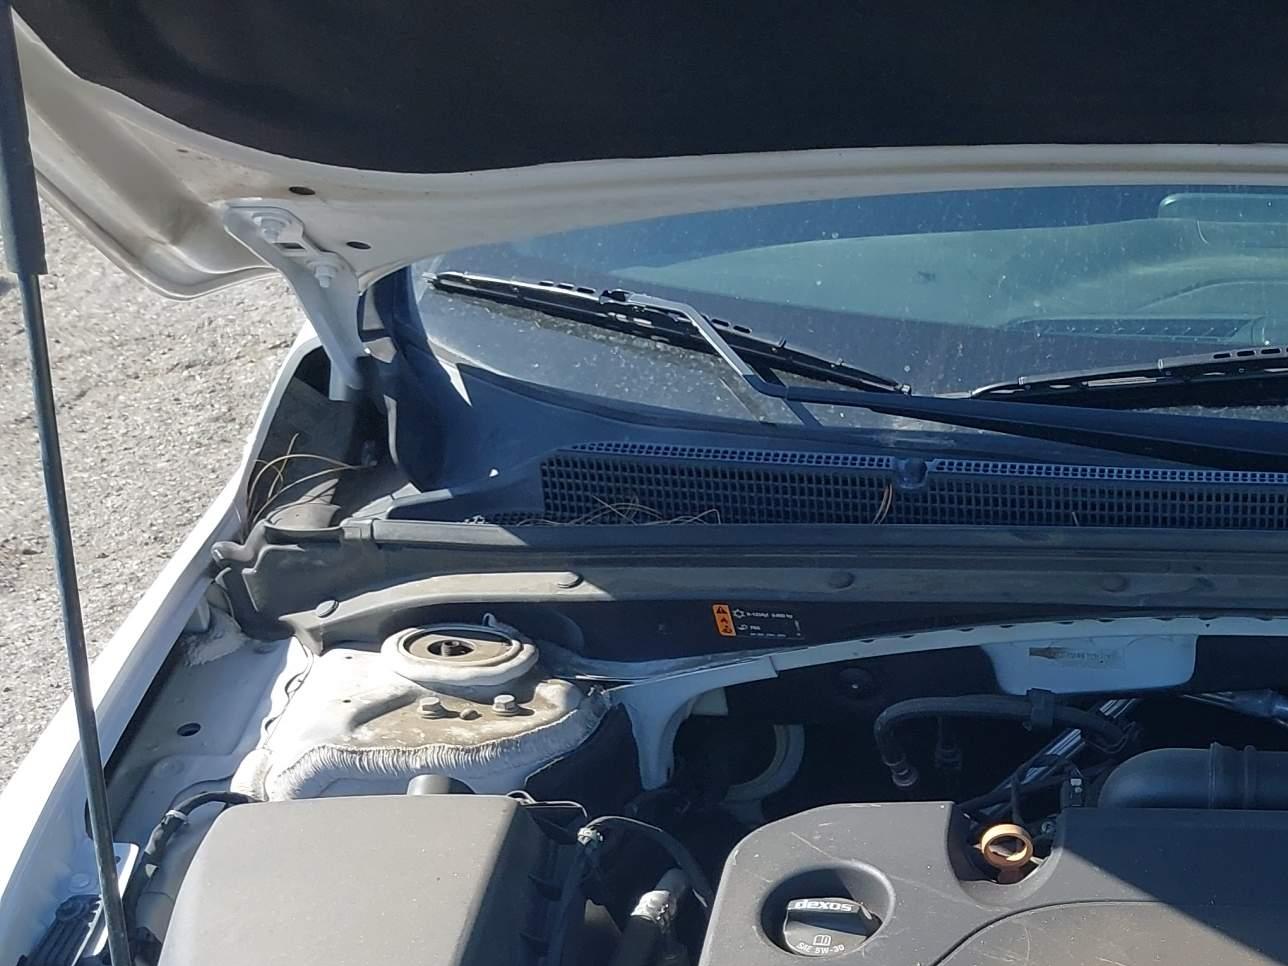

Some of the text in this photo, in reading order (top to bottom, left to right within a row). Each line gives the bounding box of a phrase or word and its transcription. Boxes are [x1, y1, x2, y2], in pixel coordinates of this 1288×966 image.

[794, 899, 852, 912] dexos
[796, 942, 845, 954] SAE 5W-30
